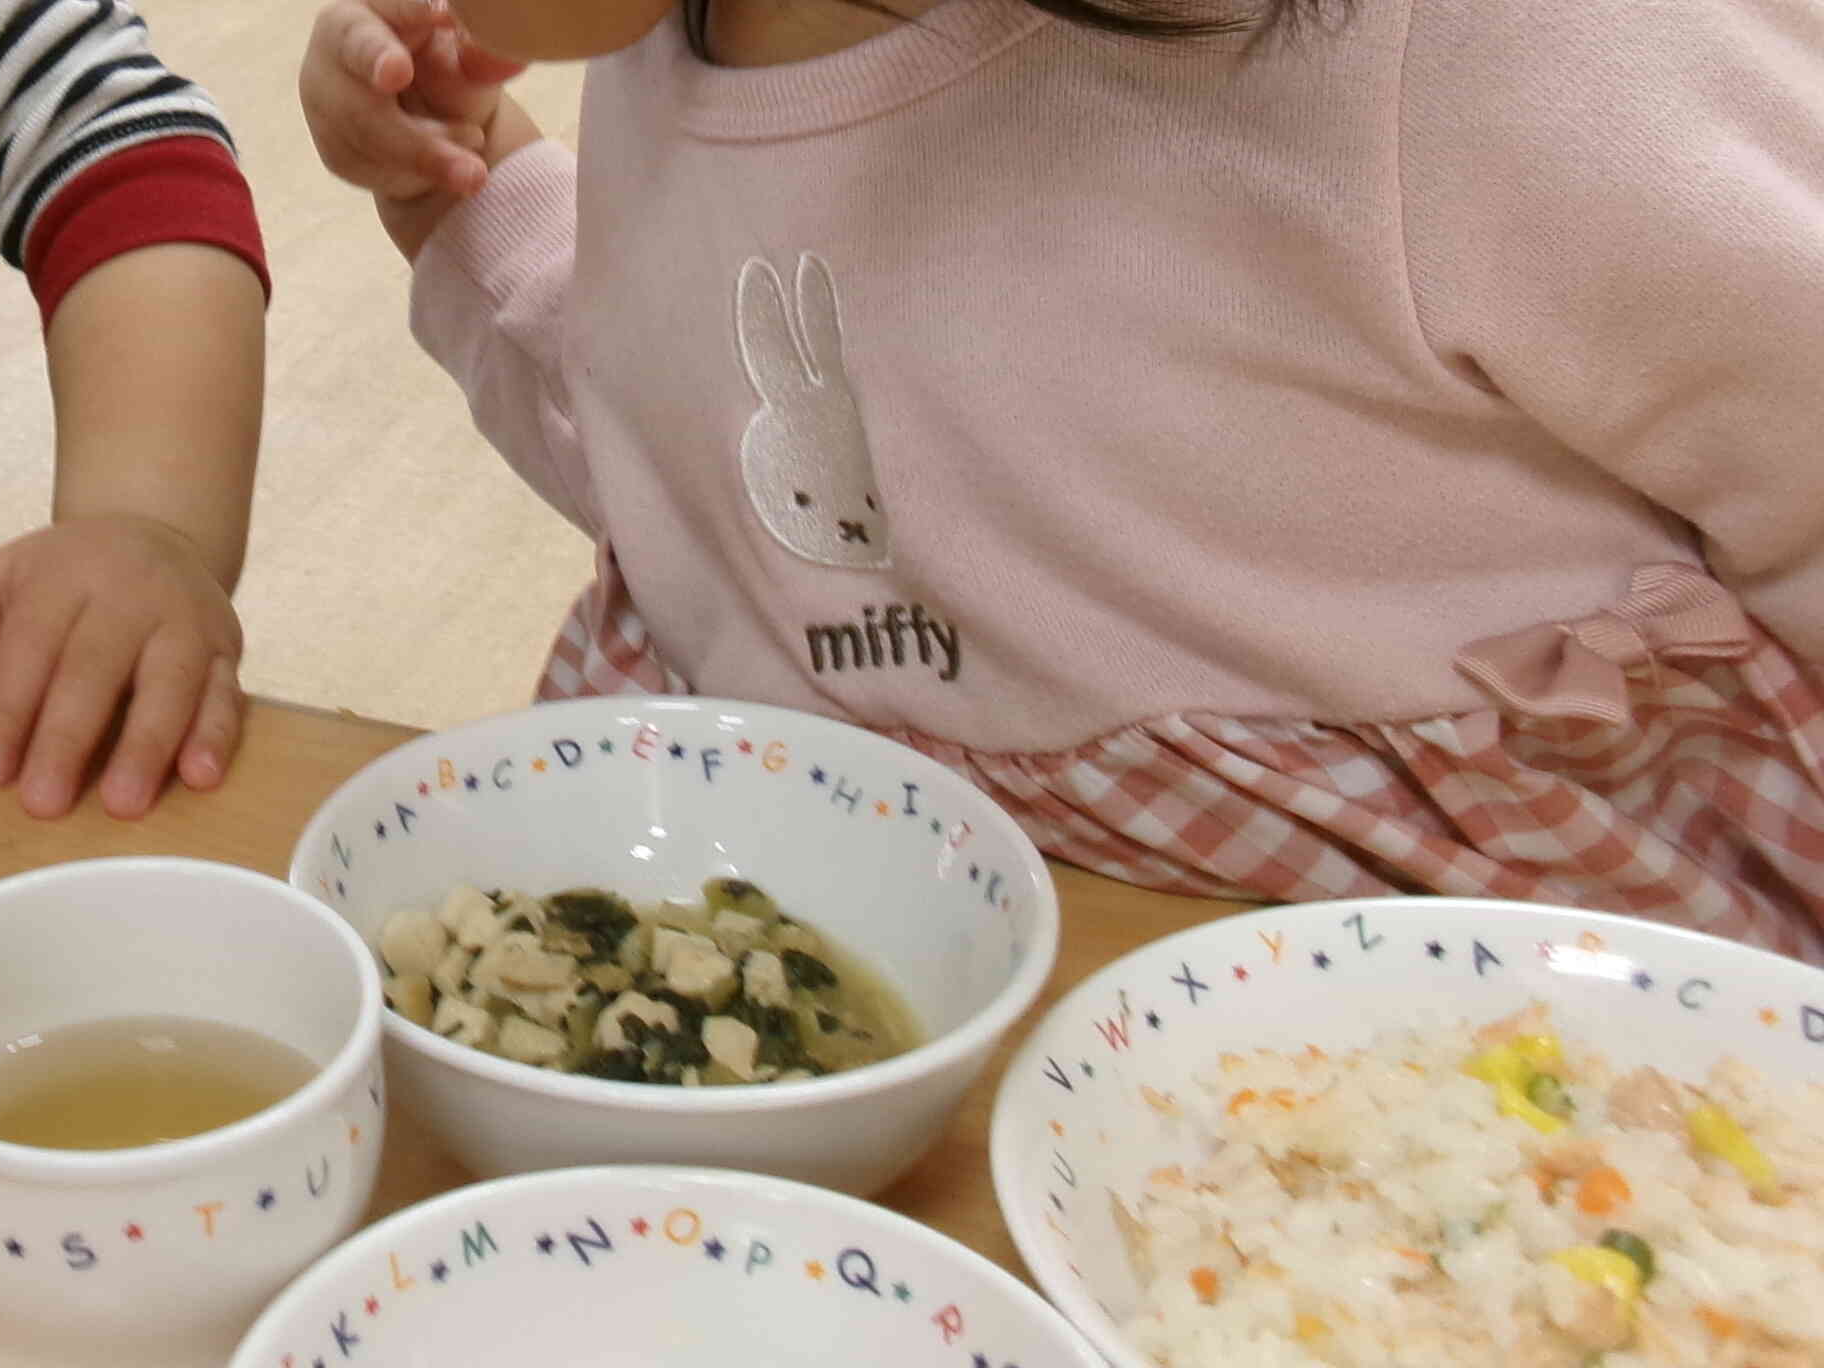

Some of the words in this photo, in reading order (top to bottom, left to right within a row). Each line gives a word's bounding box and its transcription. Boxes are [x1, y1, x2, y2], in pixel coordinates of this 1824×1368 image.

[804, 603, 962, 682] miffy
[394, 801, 417, 834] A
[437, 757, 457, 790] B
[491, 755, 514, 791] C
[551, 737, 583, 769] D
[631, 727, 663, 763] E
[701, 746, 724, 783] F
[760, 739, 789, 773] G
[829, 775, 864, 815] H
[901, 782, 920, 817] I
[1042, 1054, 1074, 1094] V
[1091, 1014, 1132, 1055] W
[1169, 960, 1212, 1007] X
[1255, 927, 1285, 969] Y
[1341, 911, 1386, 952] Z
[1471, 939, 1505, 977] A
[1675, 976, 1714, 1010] C
[58, 1231, 99, 1271] S
[192, 1200, 226, 1240] T
[305, 1154, 331, 1199] U
[328, 1309, 361, 1359] K
[388, 1250, 418, 1294] L
[460, 1218, 500, 1269] M
[563, 1214, 614, 1268] N
[662, 1206, 703, 1247] O
[743, 1239, 774, 1277] P
[835, 1247, 882, 1298] Q
[930, 1303, 967, 1348] R
